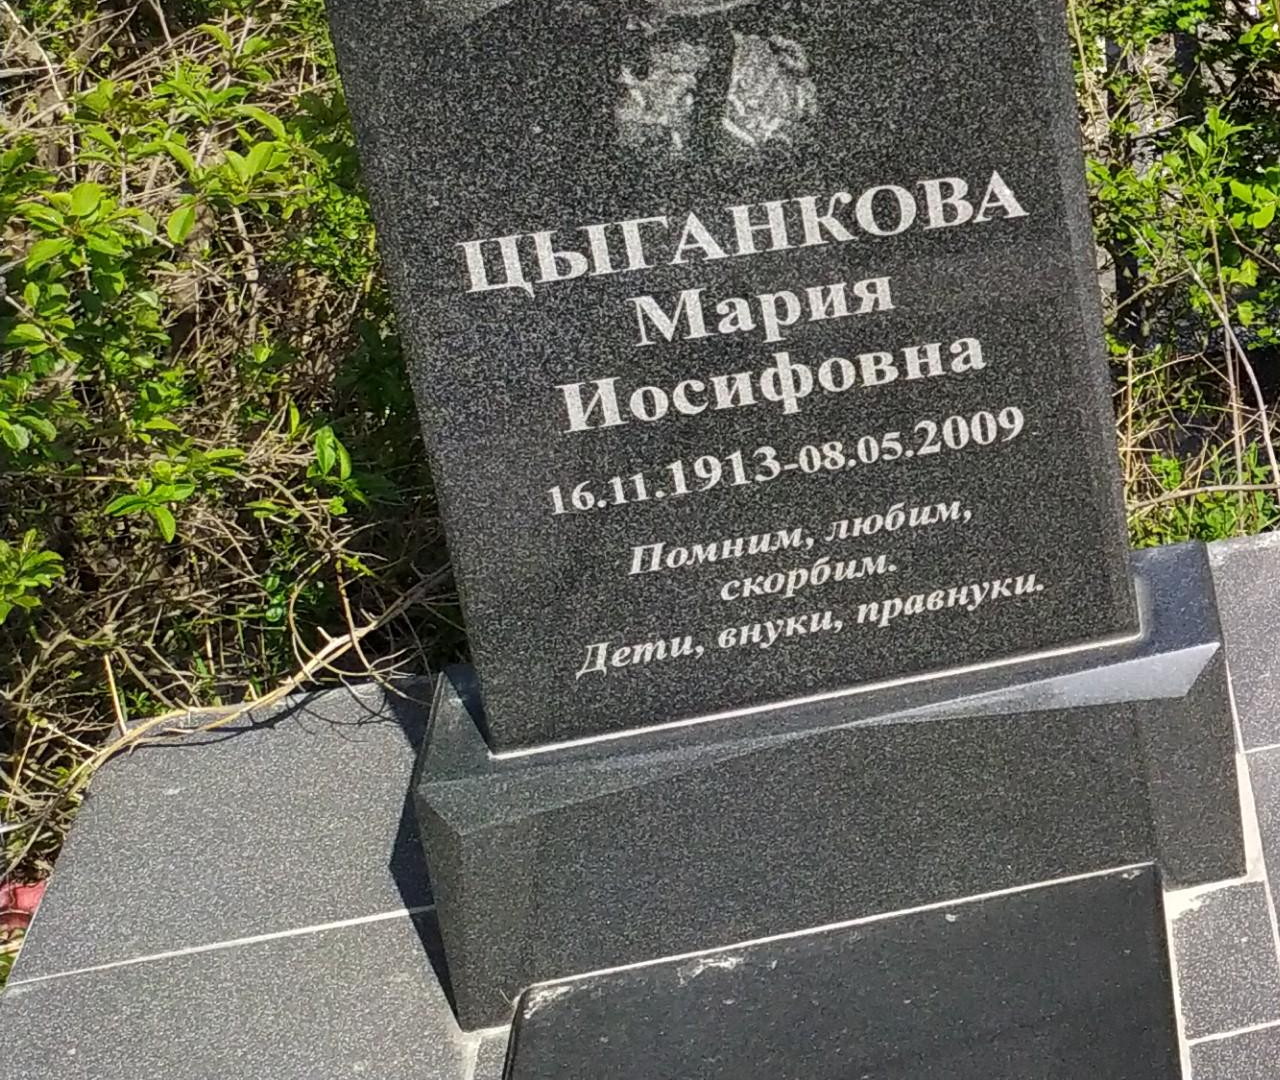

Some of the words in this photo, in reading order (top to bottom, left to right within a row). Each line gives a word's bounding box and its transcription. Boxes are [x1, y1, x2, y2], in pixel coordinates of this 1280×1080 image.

[456, 170, 1029, 298] ЦЫГАНКОВА
[627, 276, 897, 347] Мария
[555, 336, 986, 433] Иосифовна
[547, 406, 1025, 515] 16.11.1913-08.05.2009
[628, 525, 816, 576] Помним,
[825, 499, 973, 542] любим,
[720, 555, 898, 602] скорбим.
[575, 632, 705, 681] Дети,
[718, 606, 843, 650] внуки,
[857, 571, 1045, 628] правнуки.
